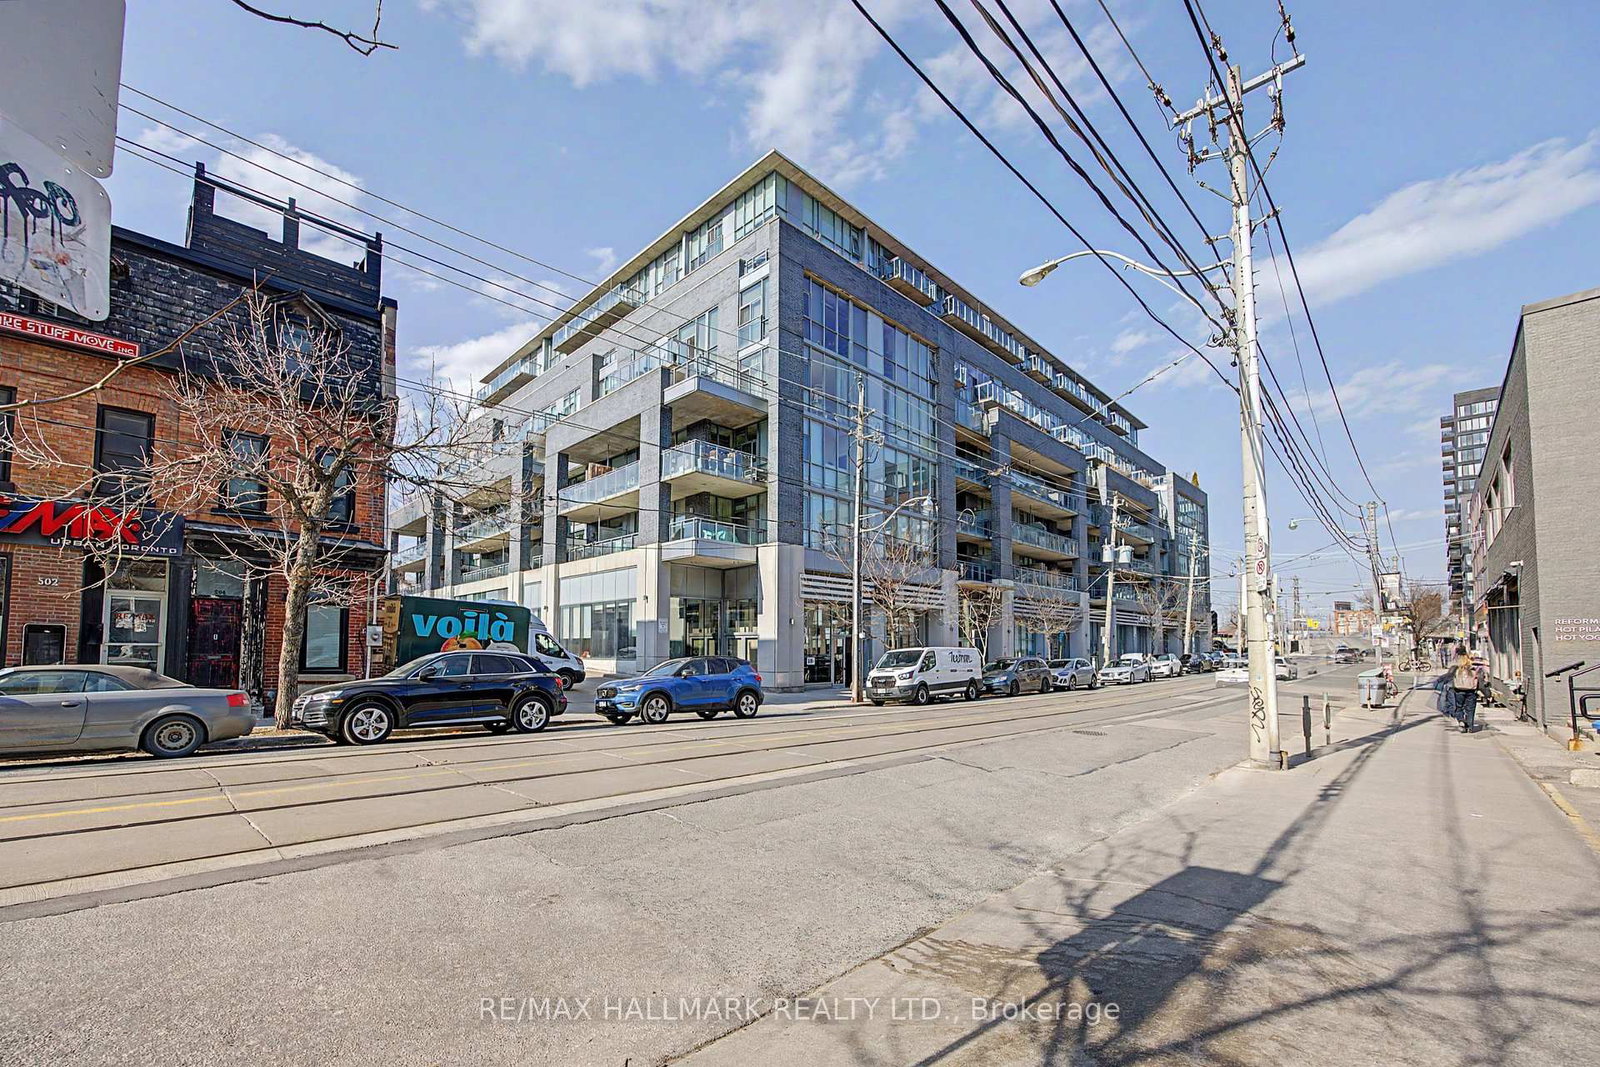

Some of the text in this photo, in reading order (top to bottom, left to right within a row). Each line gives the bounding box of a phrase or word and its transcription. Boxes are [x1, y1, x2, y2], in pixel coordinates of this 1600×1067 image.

[0, 315, 23, 329] KE
[27, 321, 70, 340] STUFF
[74, 333, 114, 349] MOVE
[114, 544, 178, 554] ORONTO
[37, 577, 59, 587] 502
[411, 611, 515, 642] voilà
